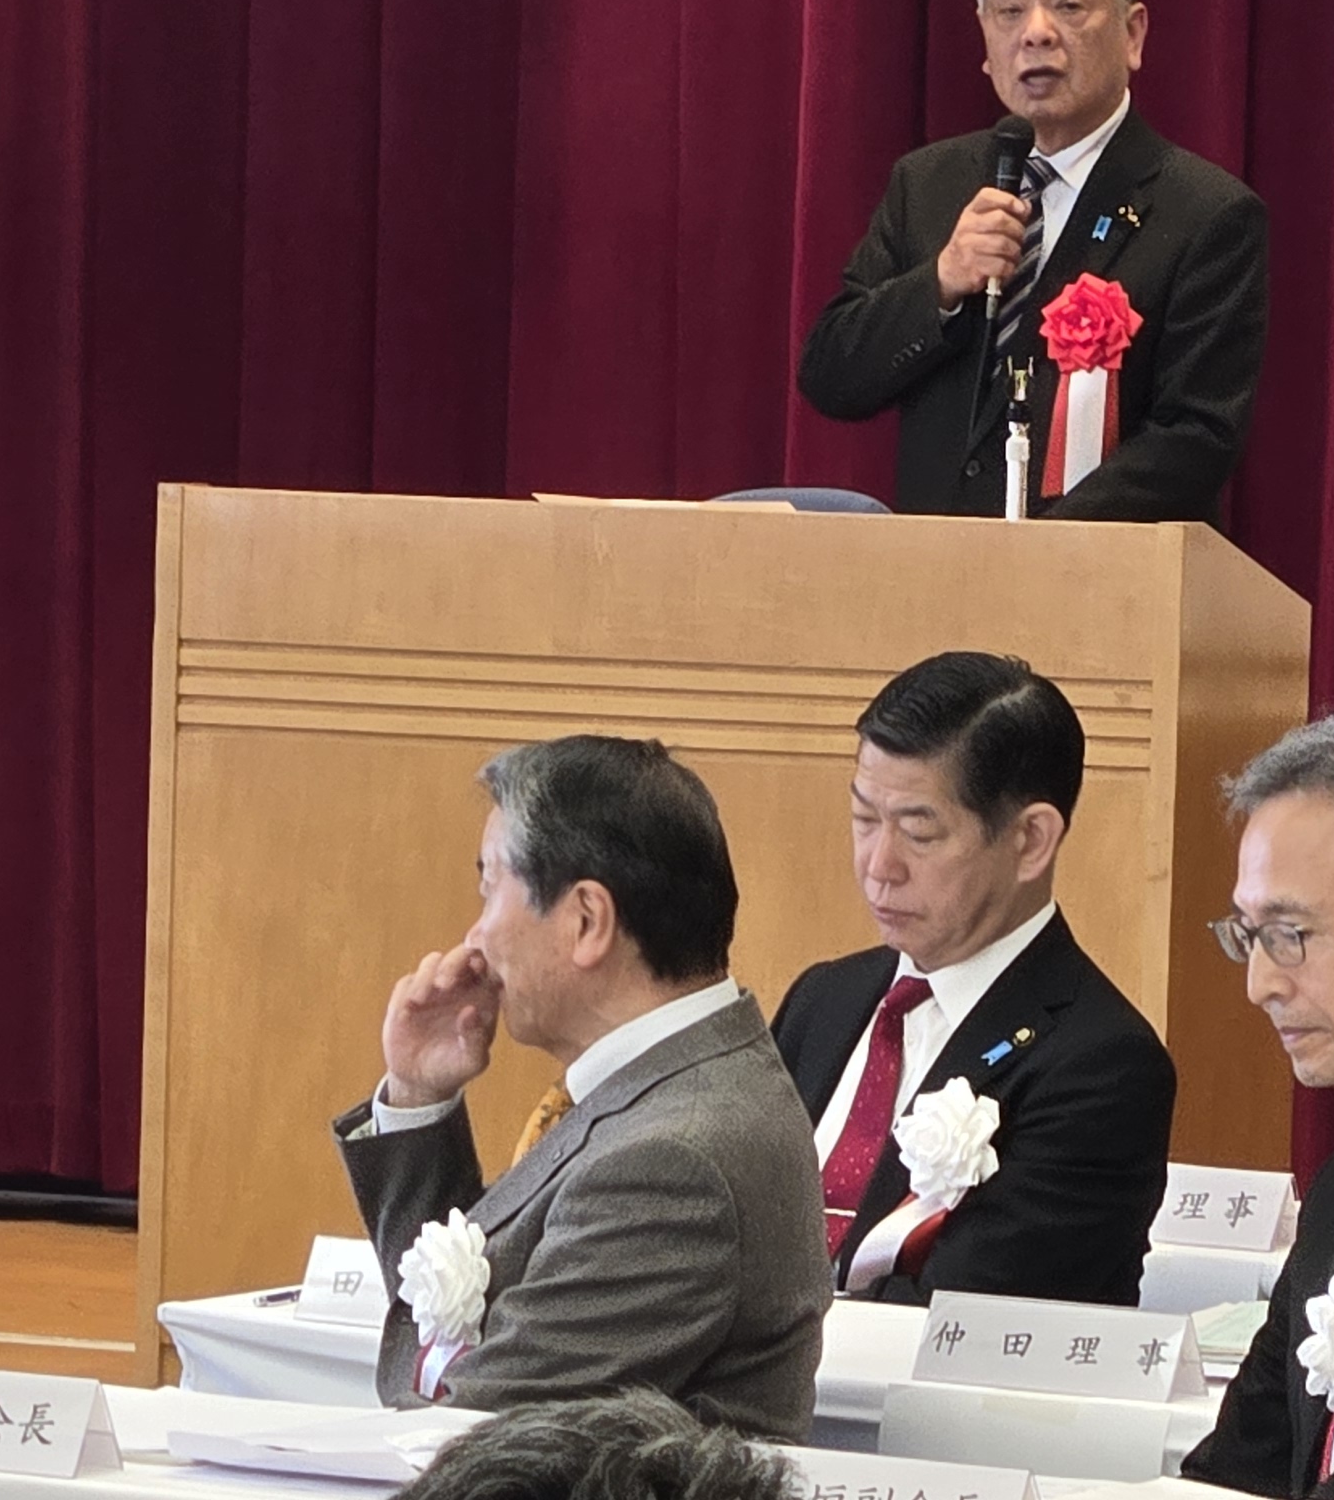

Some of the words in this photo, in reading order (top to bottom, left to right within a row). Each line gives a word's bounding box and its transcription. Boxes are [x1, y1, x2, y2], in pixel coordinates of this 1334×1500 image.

[1172, 1191, 1259, 1228] 理事
[332, 1271, 364, 1297] 田
[933, 1321, 1169, 1376] 仲田理事
